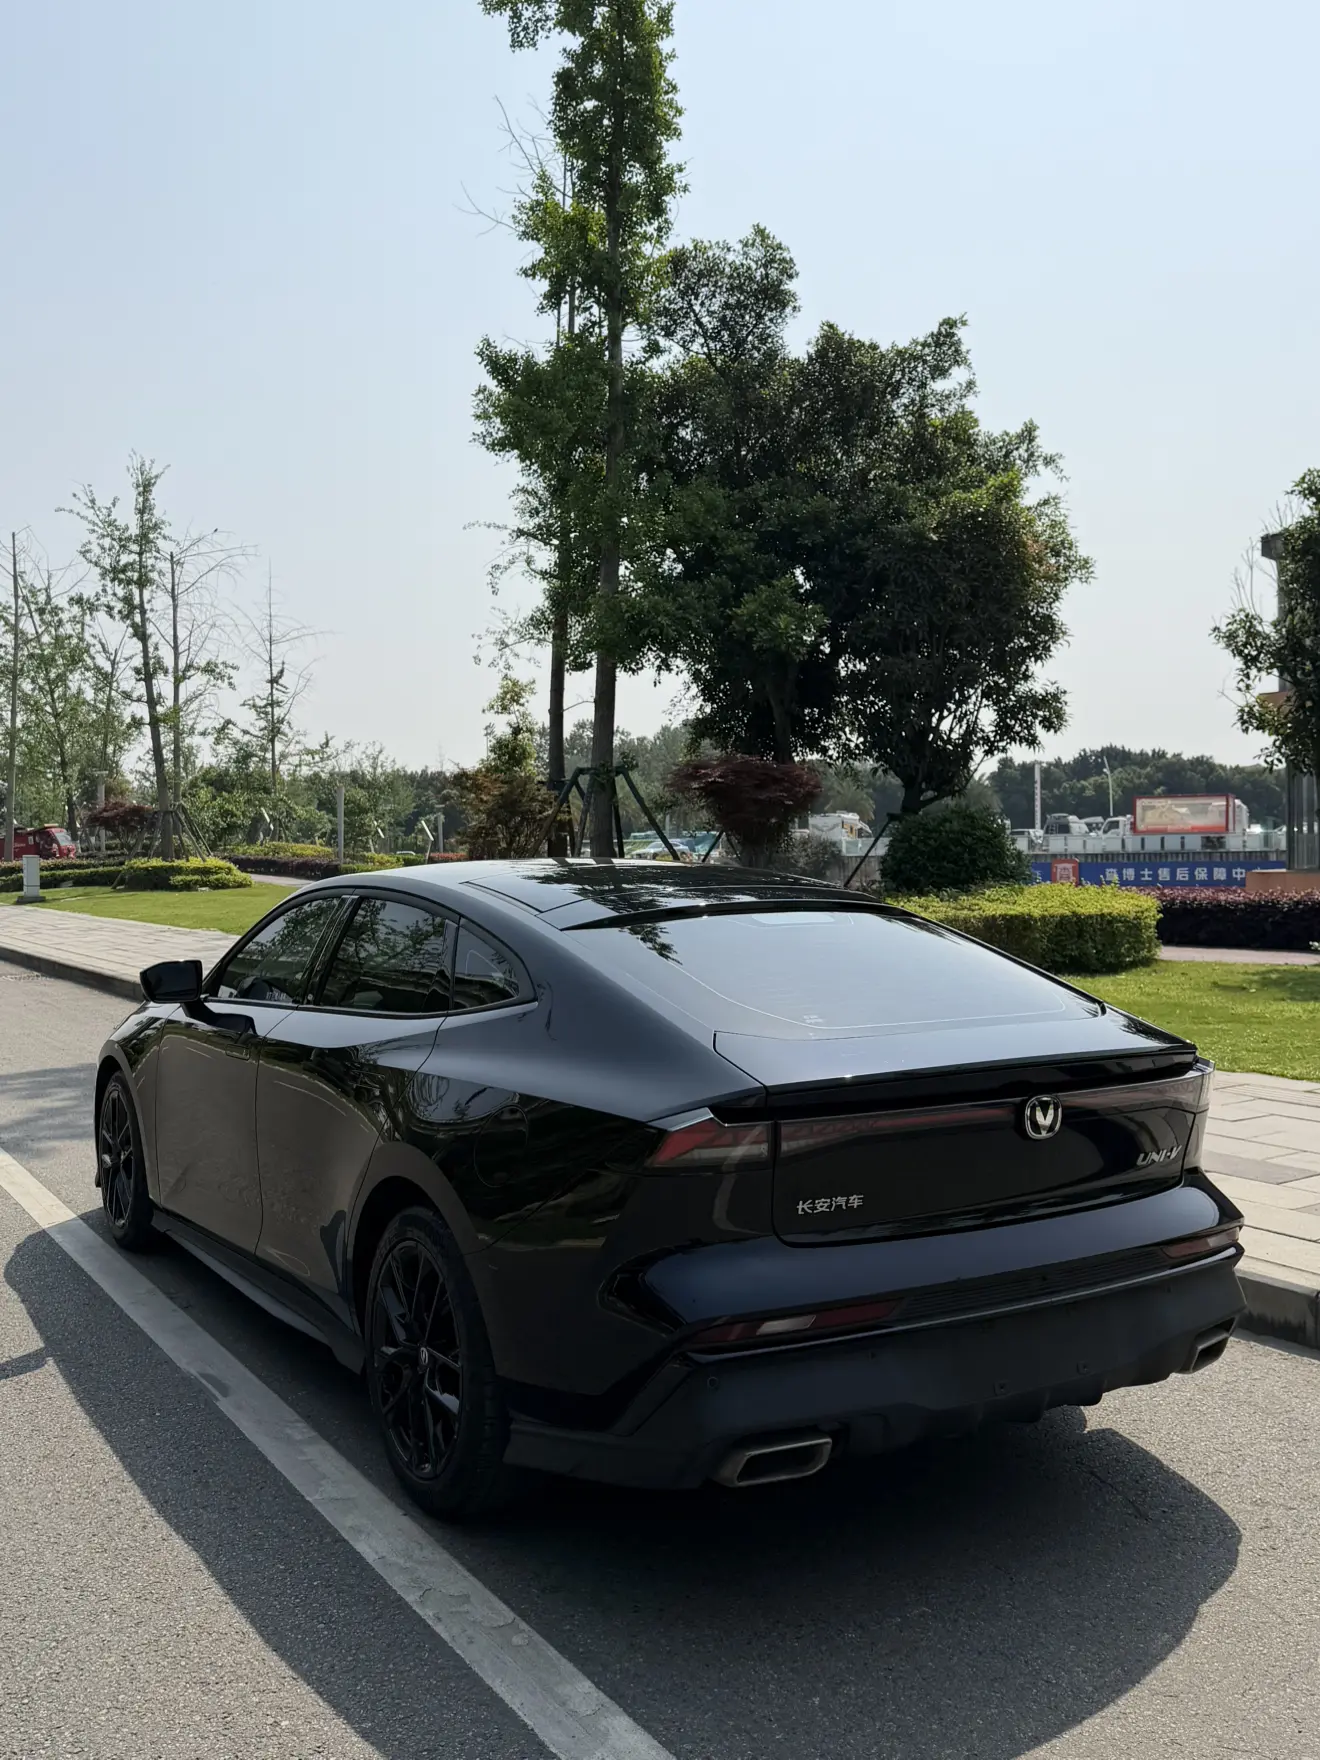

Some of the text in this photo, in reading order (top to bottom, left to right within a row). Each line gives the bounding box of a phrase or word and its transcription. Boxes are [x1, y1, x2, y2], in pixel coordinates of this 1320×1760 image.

[1105, 867, 1261, 881] 查博士售后保障中
[796, 1194, 864, 1214] 长安汽车
